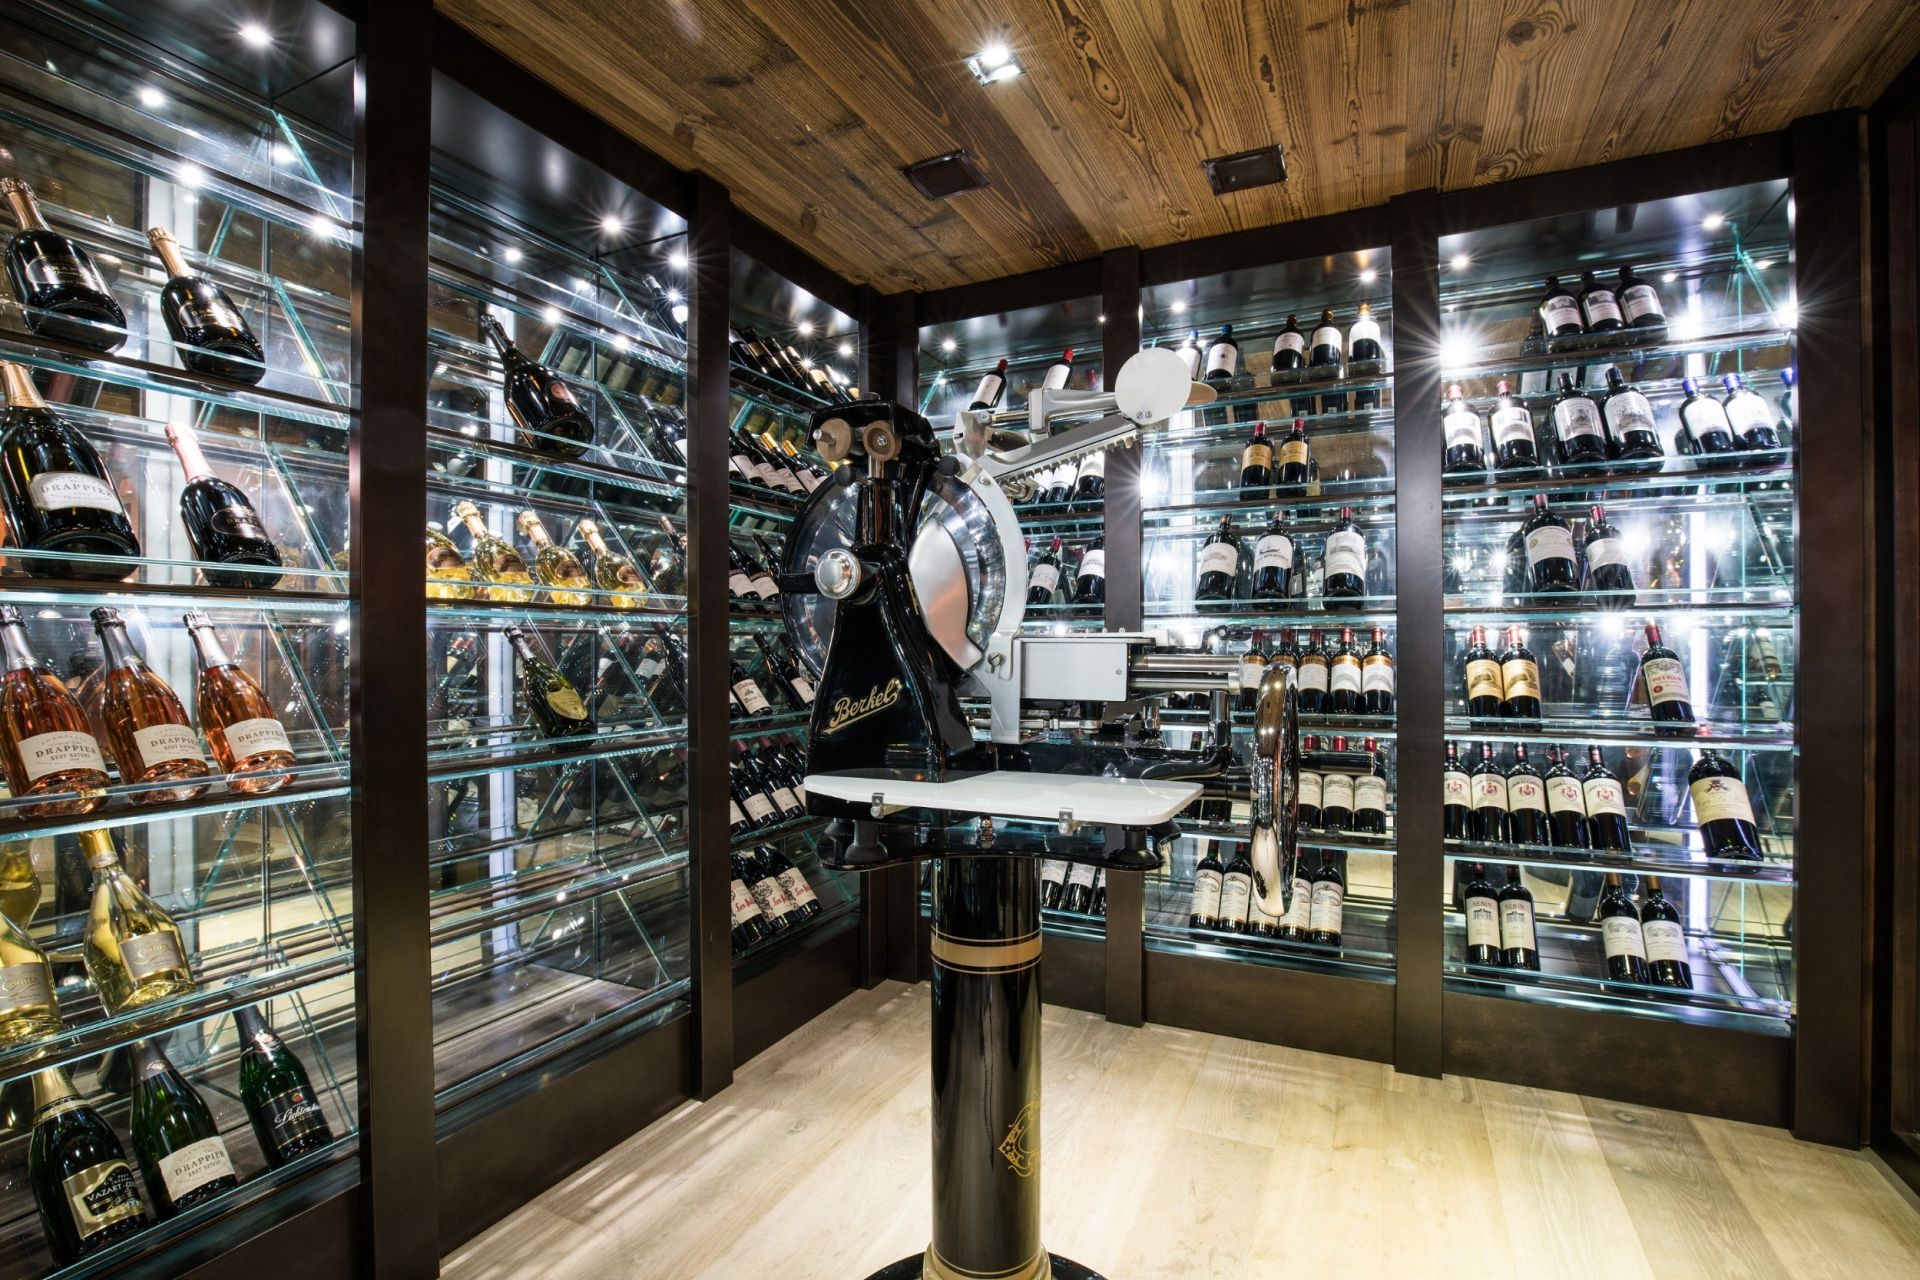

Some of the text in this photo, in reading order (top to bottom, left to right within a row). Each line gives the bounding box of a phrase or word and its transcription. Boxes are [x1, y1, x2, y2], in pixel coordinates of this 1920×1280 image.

[41, 483, 114, 498] DRAPPIER
[826, 678, 902, 731] Berkel
[237, 729, 286, 743] DRAPPIER
[35, 744, 97, 759] DRAPPIER
[175, 1150, 225, 1177] DRAPPIER
